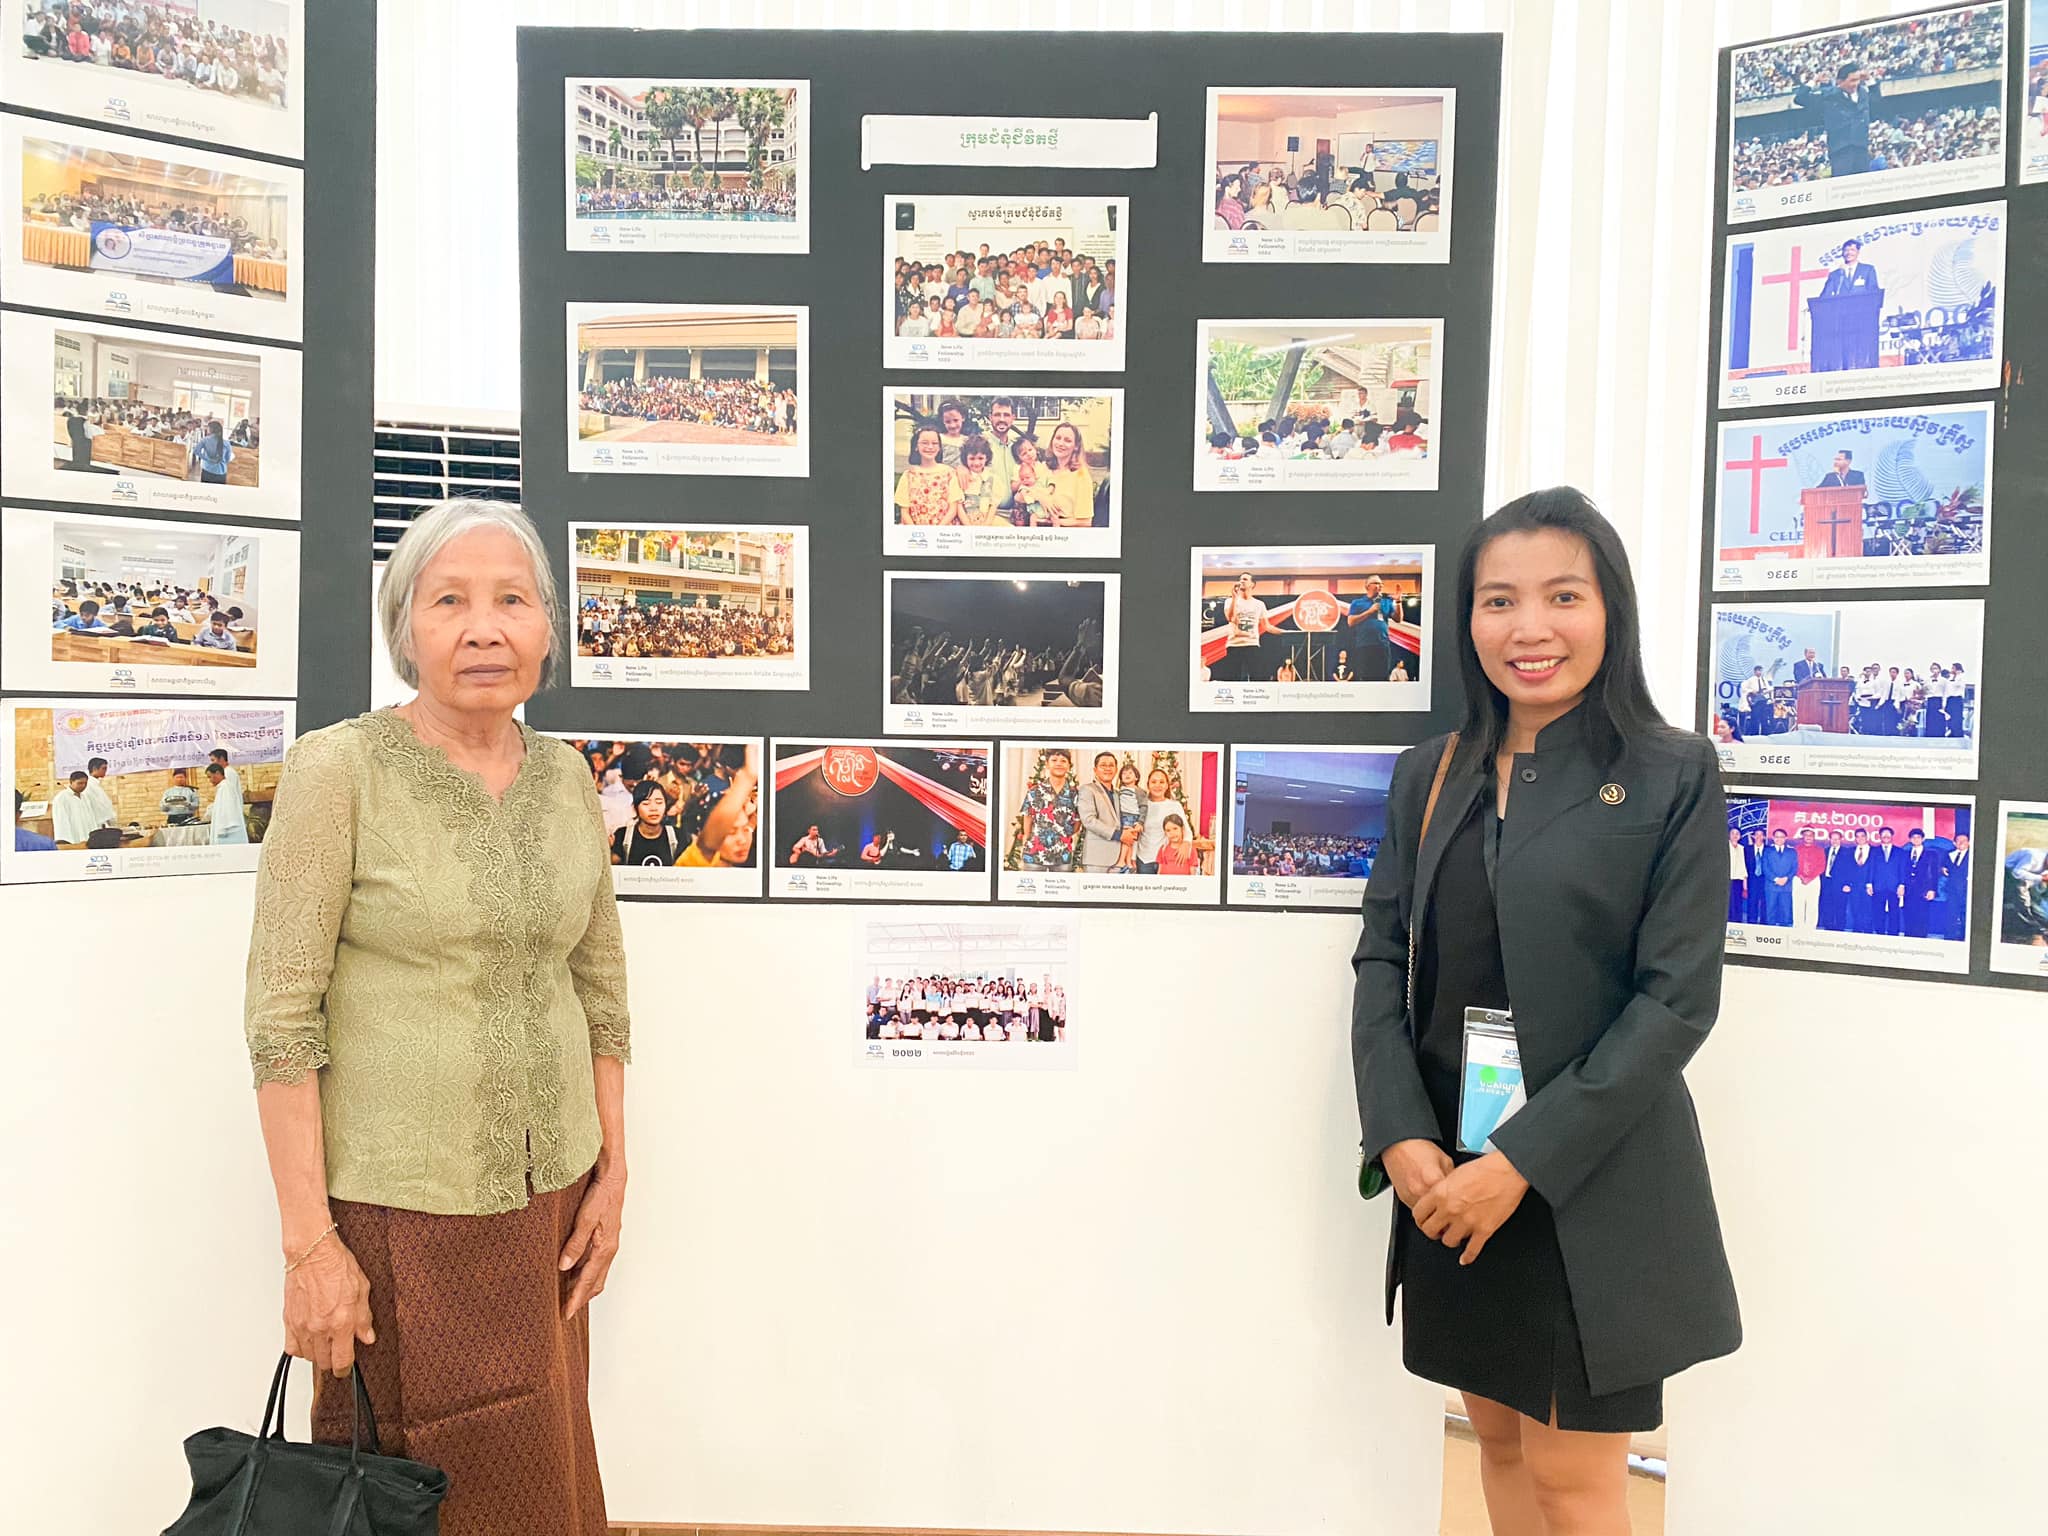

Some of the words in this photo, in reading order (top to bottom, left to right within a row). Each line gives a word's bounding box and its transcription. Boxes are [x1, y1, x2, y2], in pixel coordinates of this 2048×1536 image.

[960, 127, 1059, 150] ក្រុមជំនុំជីវិតថ្មី
[1767, 568, 1799, 580] ១៩៩៩
[1759, 754, 1791, 765] ១៩៩៩
[892, 1048, 922, 1057] ២០២២
